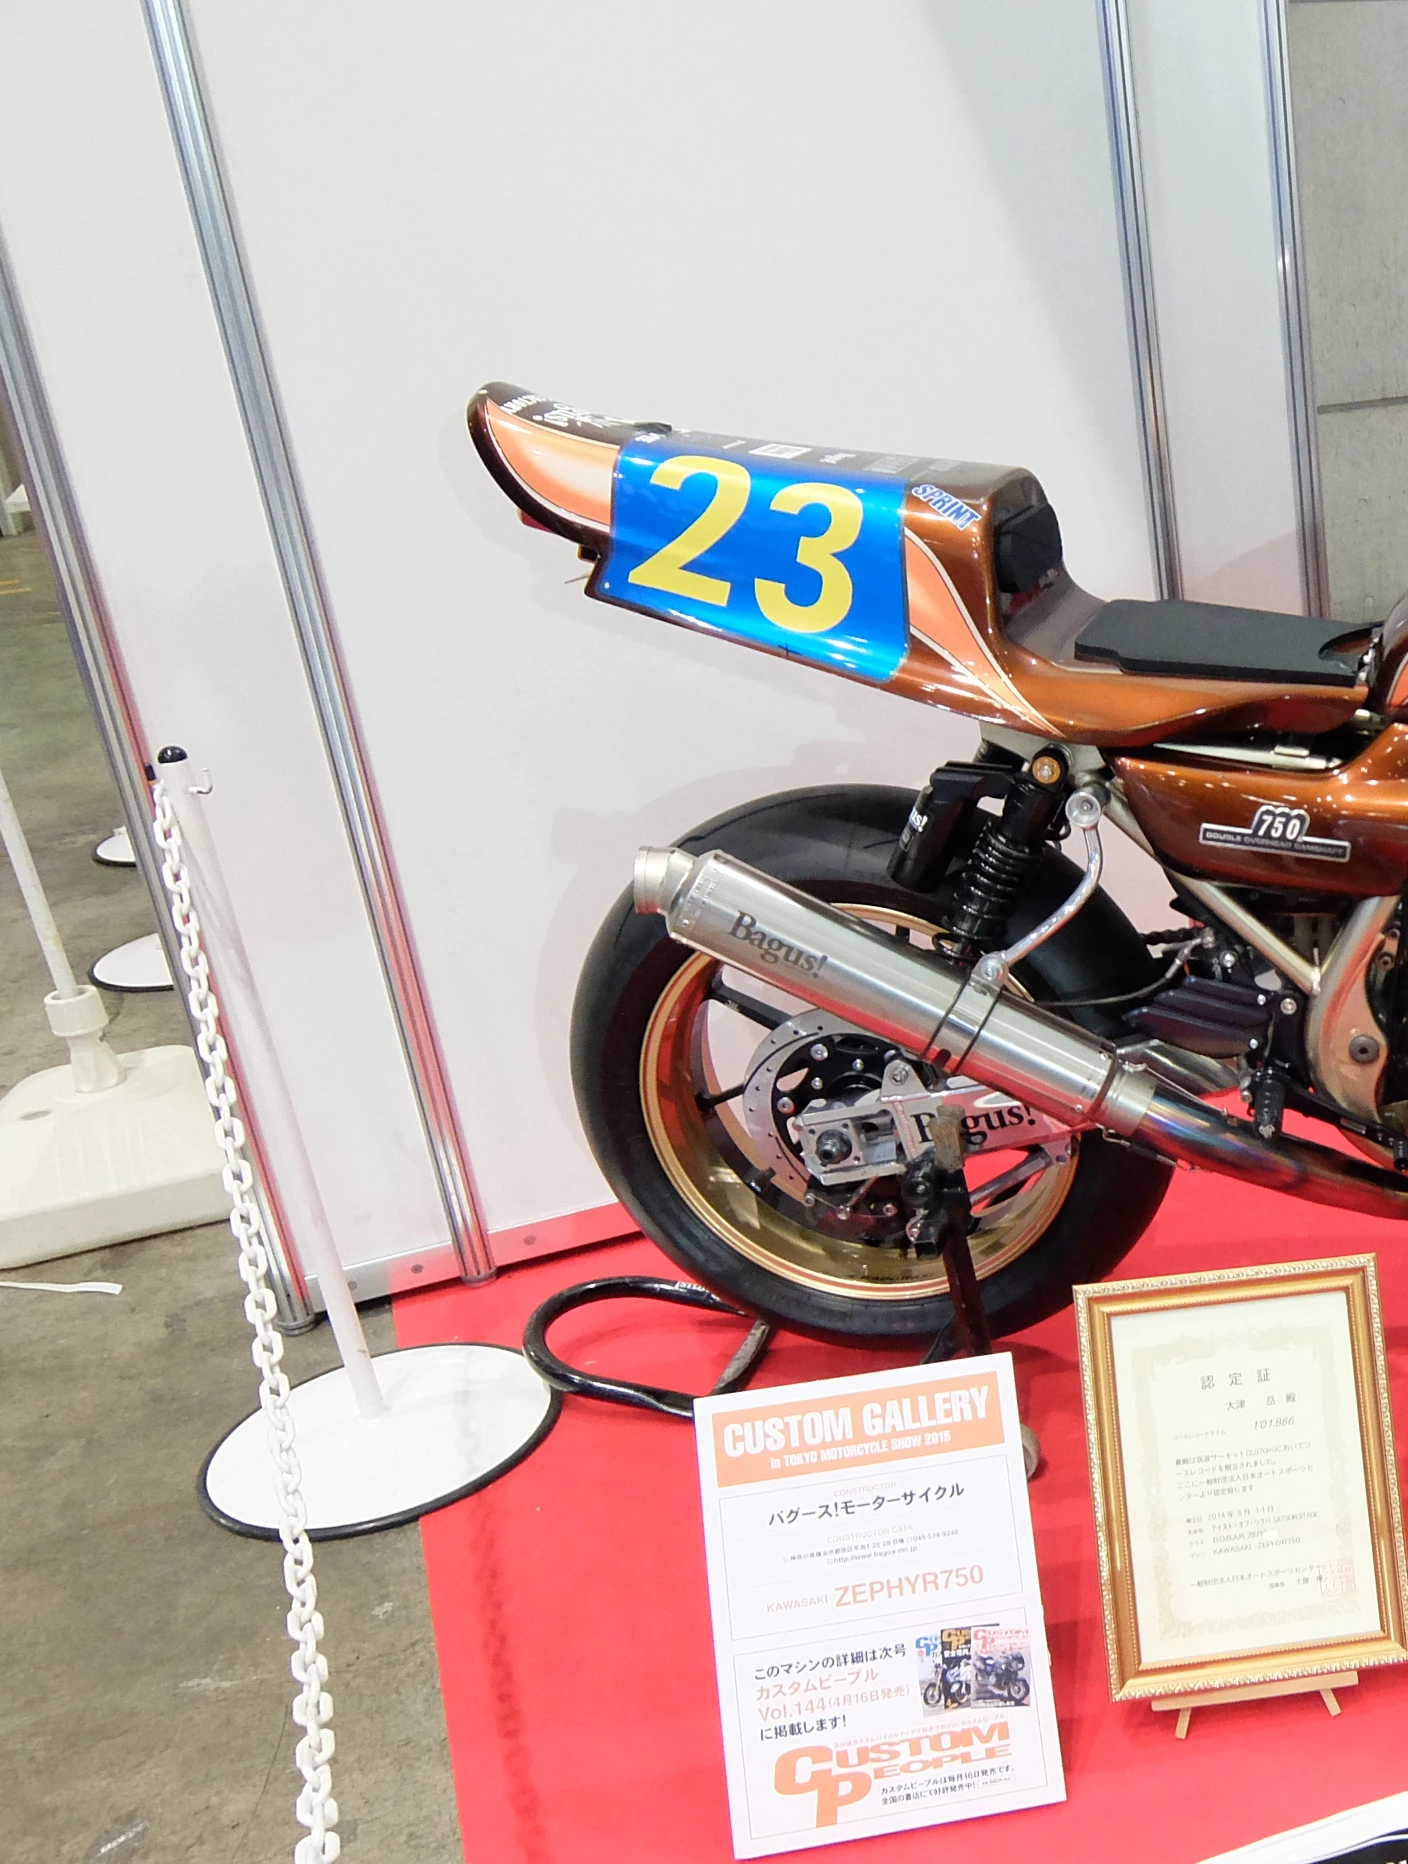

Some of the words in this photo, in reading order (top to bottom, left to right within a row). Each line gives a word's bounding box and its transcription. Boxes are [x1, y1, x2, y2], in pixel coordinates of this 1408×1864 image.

[911, 484, 980, 531] SPRINT
[627, 455, 864, 634] 23
[1258, 815, 1301, 840] 750
[727, 909, 828, 979] Bagus!
[910, 1105, 1036, 1145] Bgus!
[724, 1407, 853, 1458] CUSTOM
[862, 1385, 989, 1436] GALLERY
[770, 1457, 781, 1470] in
[783, 1451, 818, 1468] TOKYO
[820, 1440, 889, 1463] MOTORCYCLE
[891, 1434, 922, 1452] SHOW
[925, 1430, 951, 1446] 2015
[766, 1594, 829, 1613] KAWASAKI
[834, 1564, 984, 1608] ZEPHYR750
[774, 1721, 1011, 1796] CUSTOM
